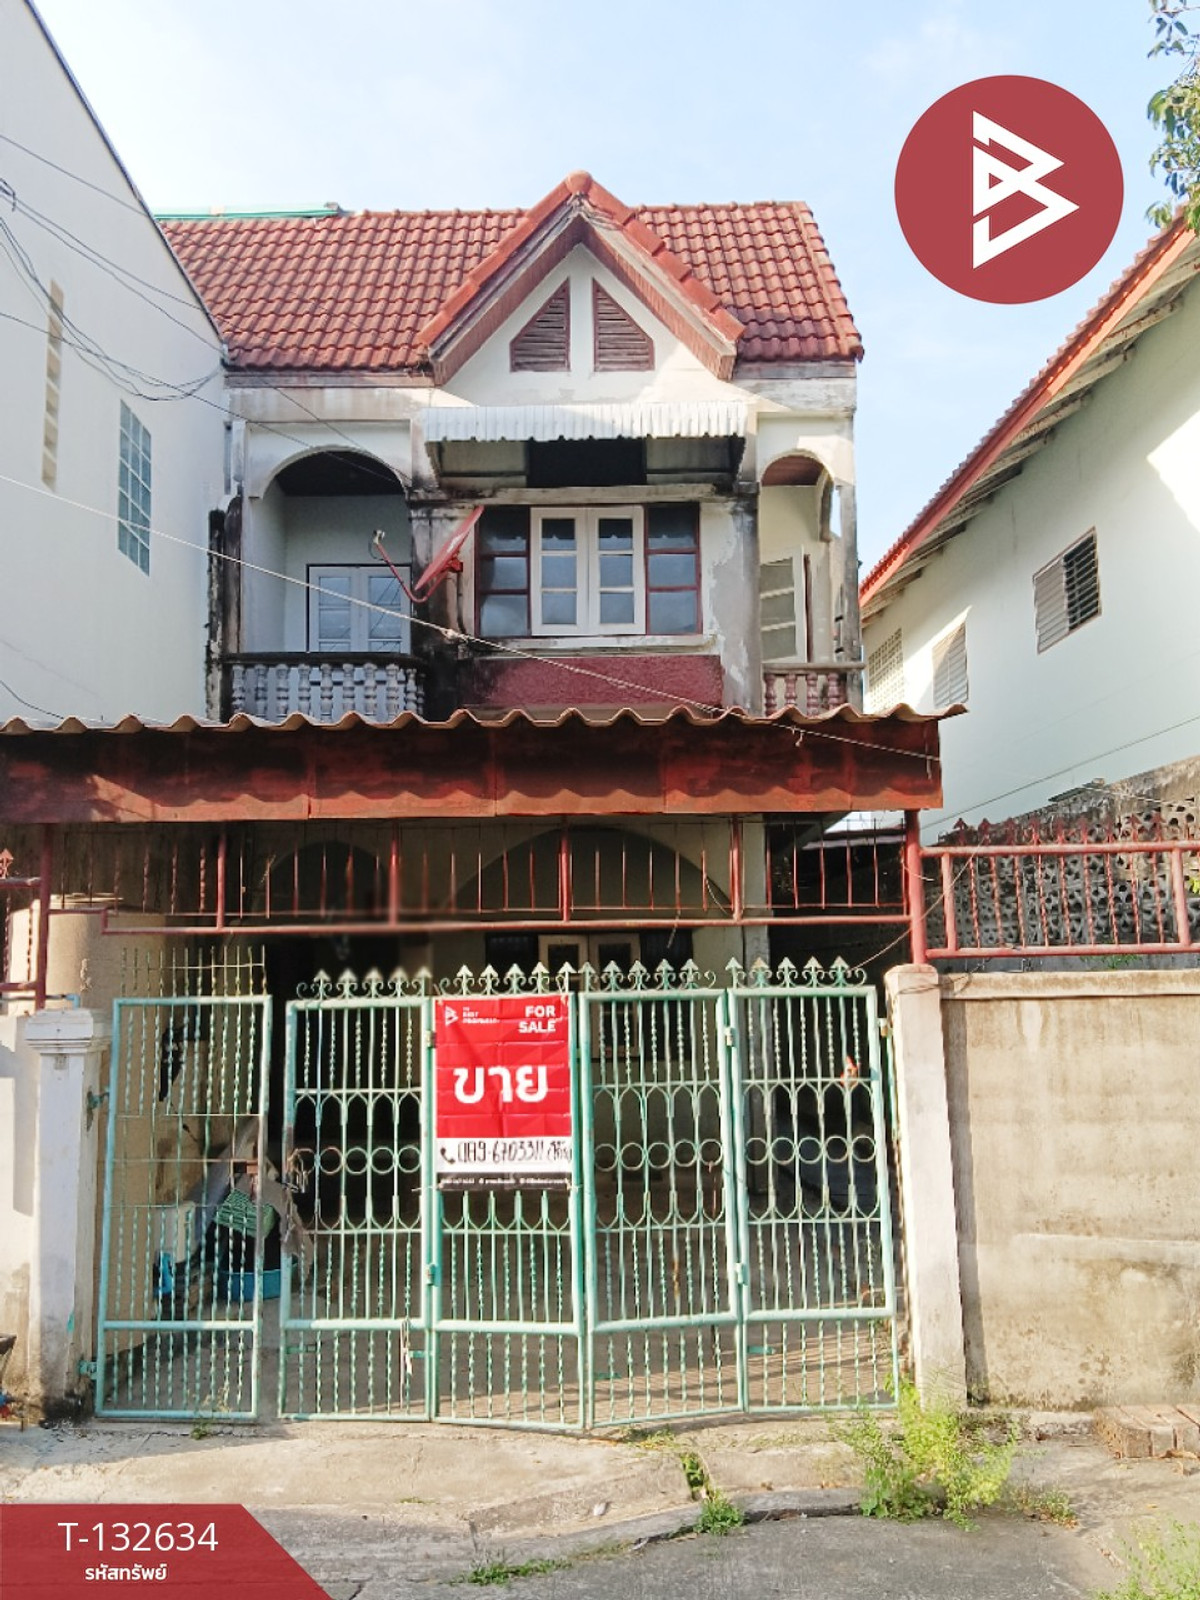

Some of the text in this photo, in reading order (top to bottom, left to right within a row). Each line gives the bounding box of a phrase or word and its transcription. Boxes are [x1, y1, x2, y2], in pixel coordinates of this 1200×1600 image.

[525, 1005, 556, 1018] FOR
[518, 1020, 557, 1034] SALE
[453, 1065, 549, 1104] ขาย
